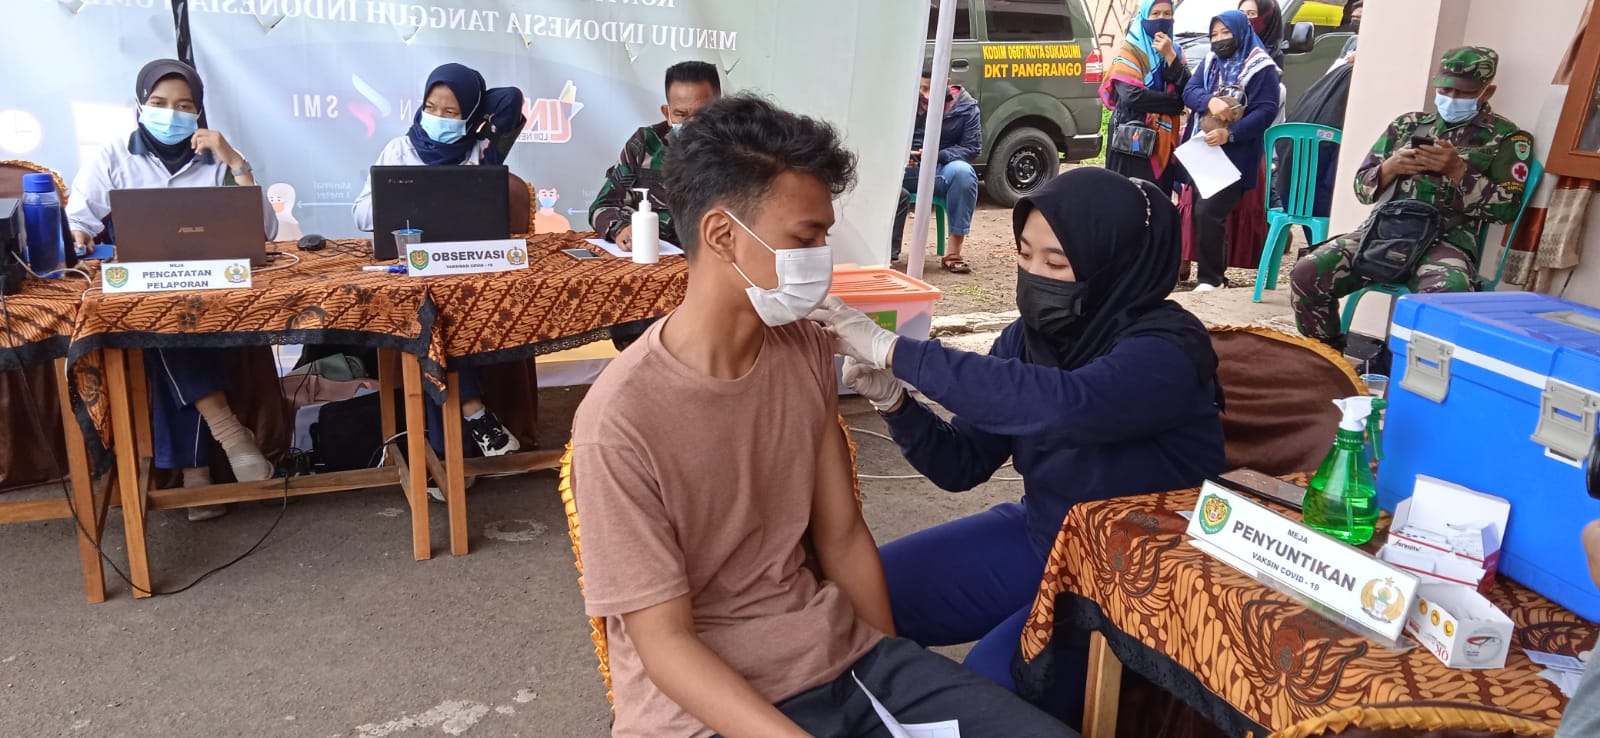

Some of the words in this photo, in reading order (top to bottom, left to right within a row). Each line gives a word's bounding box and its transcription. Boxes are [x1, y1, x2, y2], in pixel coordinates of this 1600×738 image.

[982, 45, 1007, 59] KODIM
[1045, 44, 1081, 58] SUKABUMI
[984, 63, 1009, 78] DKT
[1011, 62, 1082, 77] PANGRANGO
[431, 250, 505, 262] OBSERVASI
[142, 269, 212, 279] PENCATATAN
[146, 280, 209, 289] PELAPORAN
[1287, 529, 1308, 544] MEJA
[1232, 520, 1357, 592] PENYUNTIKAN
[1252, 551, 1280, 571] VAKSIN
[1280, 566, 1304, 583] COVID
[1310, 582, 1320, 591] 19
